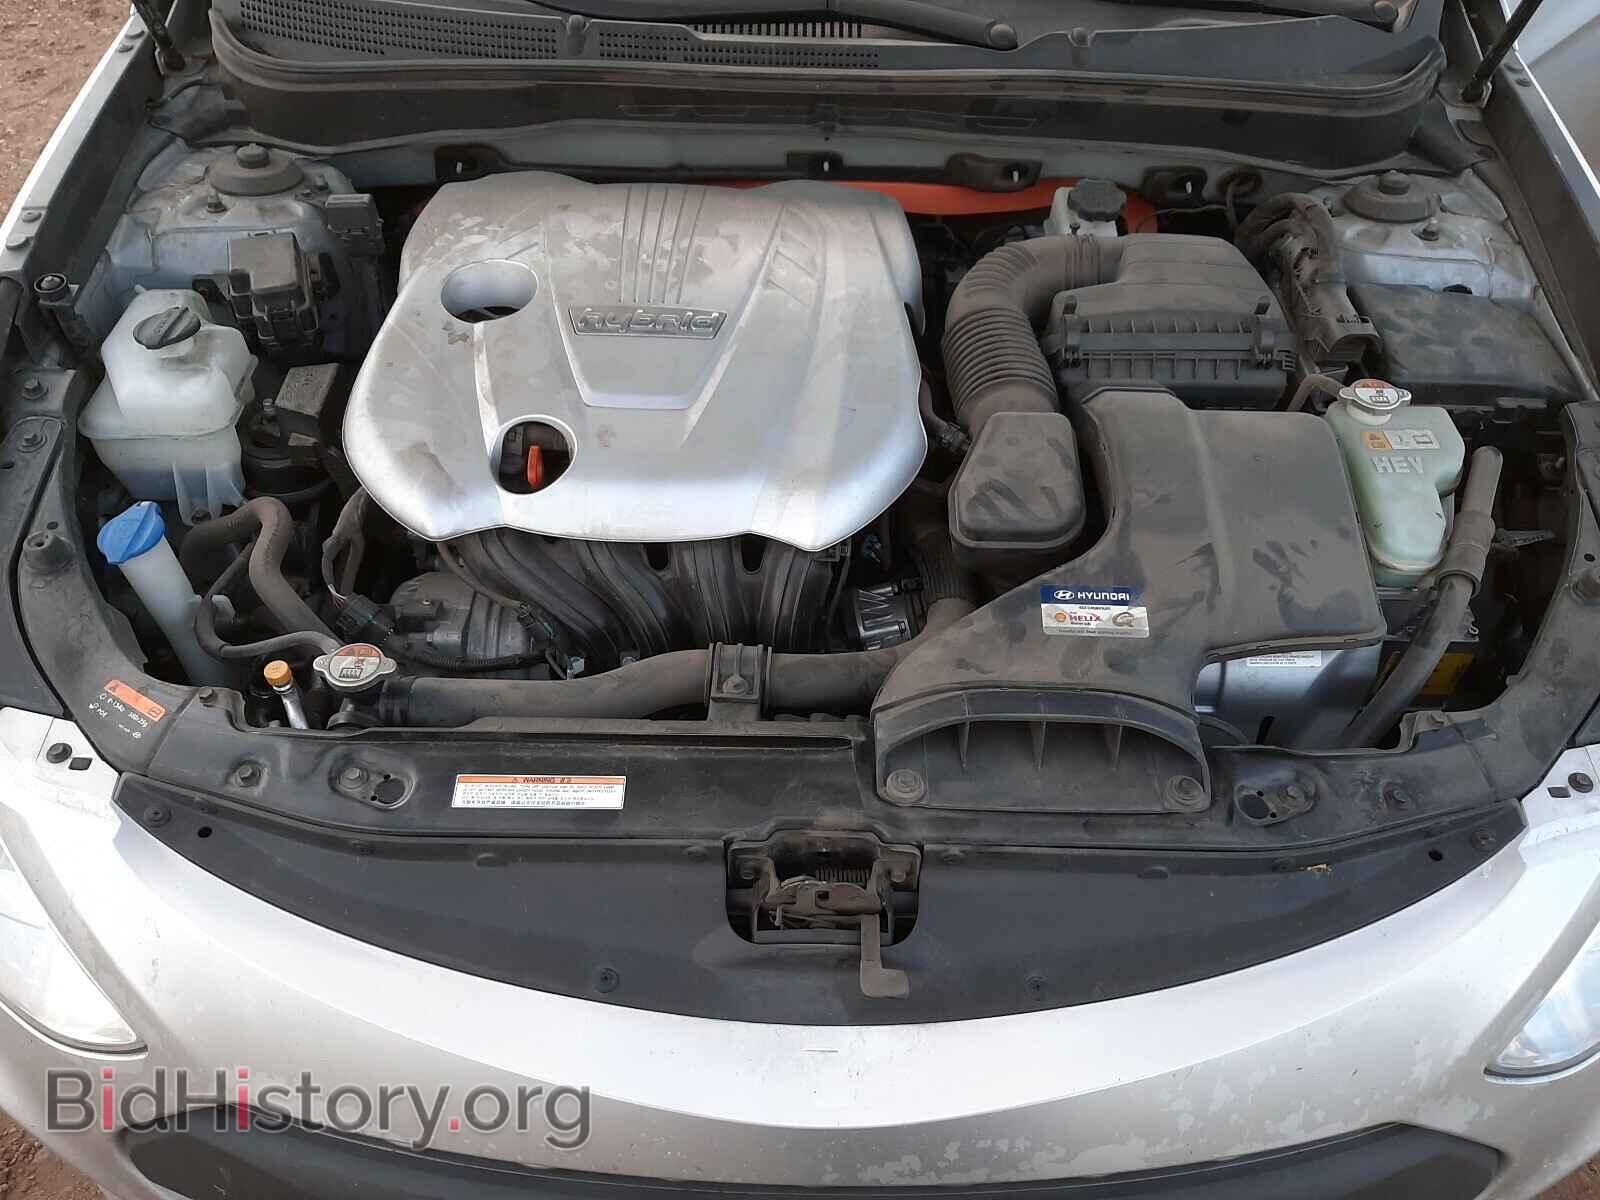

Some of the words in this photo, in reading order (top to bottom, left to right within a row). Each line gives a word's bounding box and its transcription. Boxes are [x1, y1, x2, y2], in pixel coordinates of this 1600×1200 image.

[577, 308, 720, 333] hybrid
[1372, 456, 1424, 473] HEV
[1077, 592, 1130, 601] HYUNDAI
